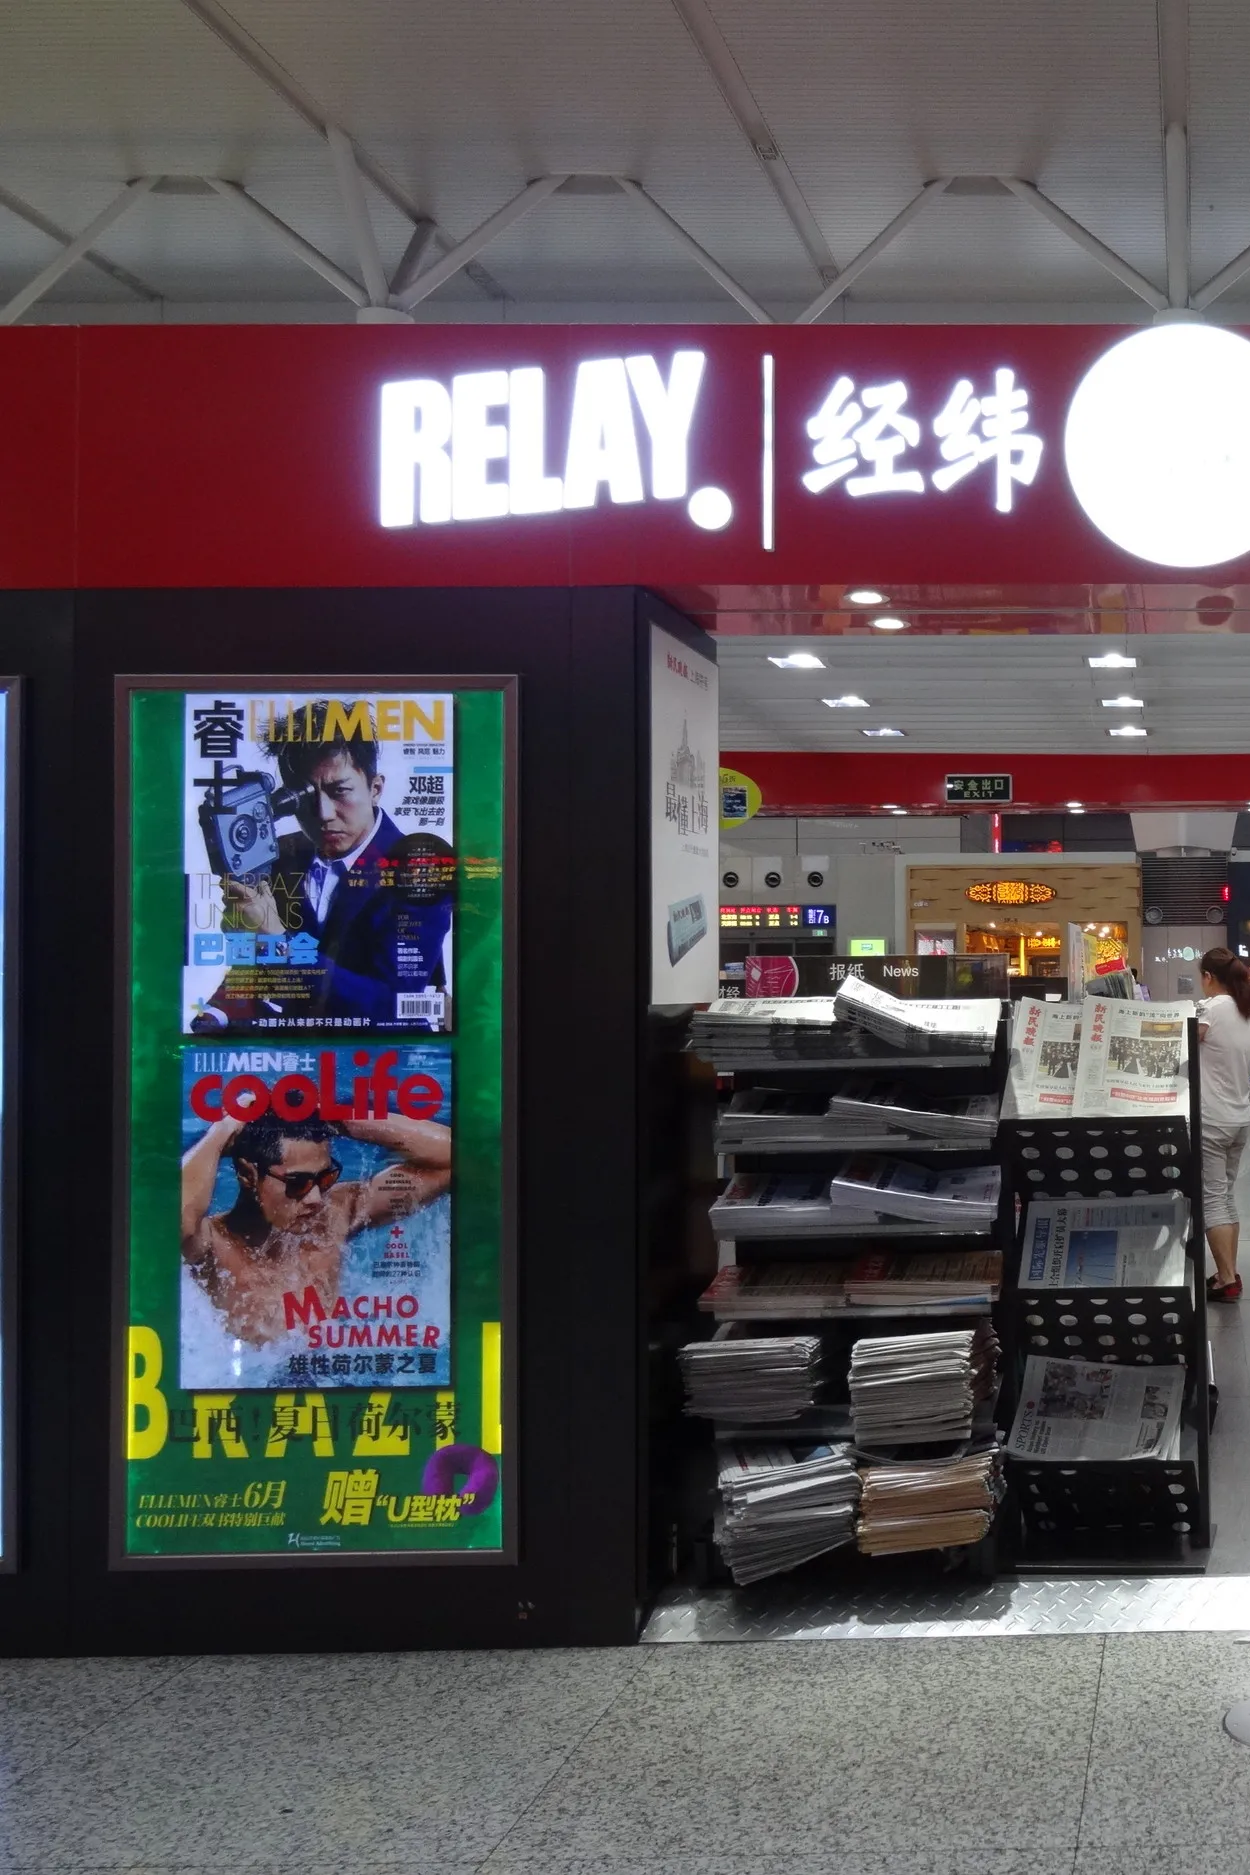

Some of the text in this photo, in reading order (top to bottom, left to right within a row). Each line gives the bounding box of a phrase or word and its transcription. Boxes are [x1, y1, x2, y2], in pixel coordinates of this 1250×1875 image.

[802, 367, 1044, 513] 经纬
[193, 700, 244, 815] 睿士
[409, 775, 445, 795] 邓超
[953, 779, 1004, 791] 安全出口
[196, 872, 238, 899] THE
[194, 902, 304, 930] UNIONS
[194, 932, 321, 966] 巴西工会
[830, 963, 865, 981] 报纸
[883, 965, 920, 977] News
[259, 1017, 371, 1027] 动画片从来都不只是动画片
[1023, 1005, 1042, 1047] 新民晚报
[1091, 1002, 1108, 1043] 新民晚报
[282, 1285, 419, 1330] MACHO
[307, 1325, 441, 1349] SUMMER
[288, 1352, 438, 1376] 雄性荷尔蒙之夏
[1015, 1411, 1033, 1451] SPORTS
[320, 1468, 380, 1526] 赠
